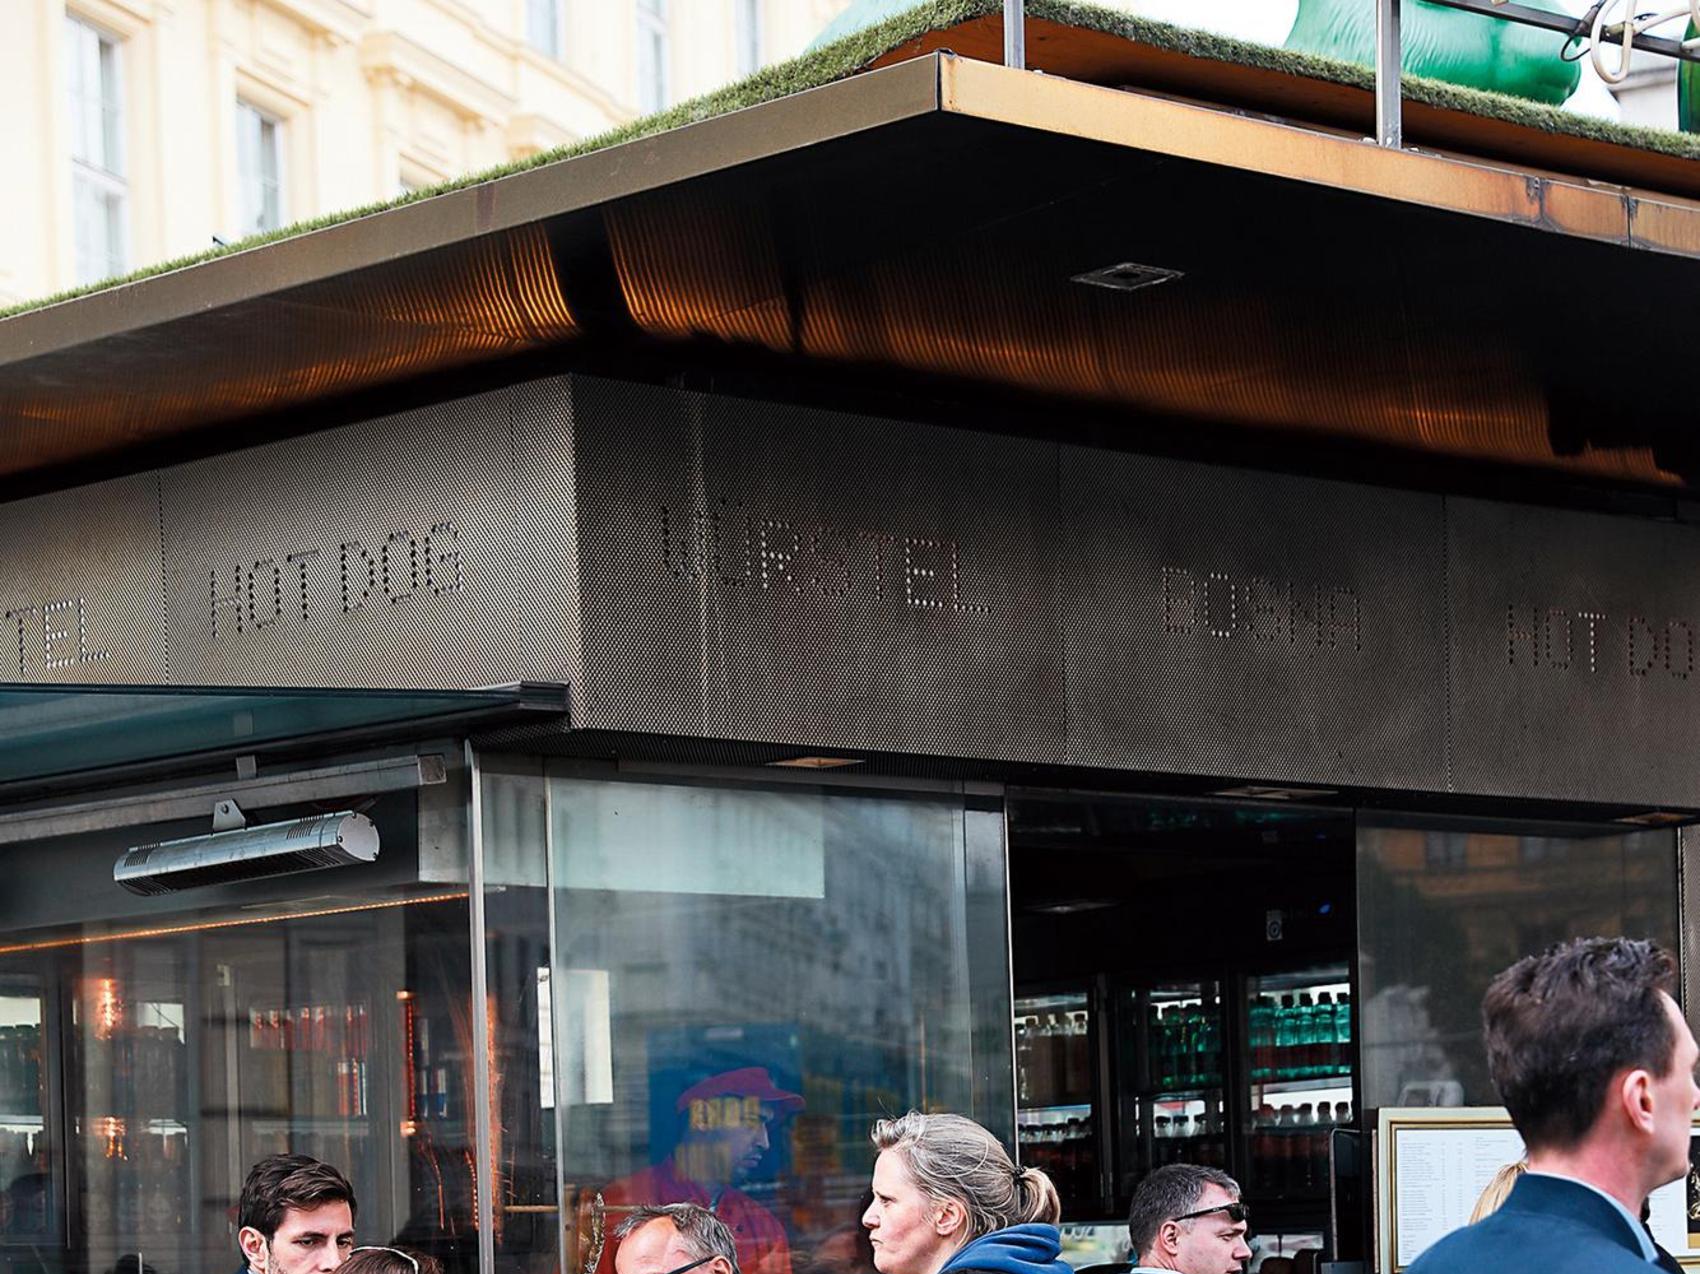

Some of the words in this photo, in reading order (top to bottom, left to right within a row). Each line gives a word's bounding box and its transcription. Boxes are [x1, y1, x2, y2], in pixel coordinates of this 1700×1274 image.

[210, 549, 320, 639] HOT
[340, 521, 465, 615] DOG
[1507, 604, 1607, 673] HOT
